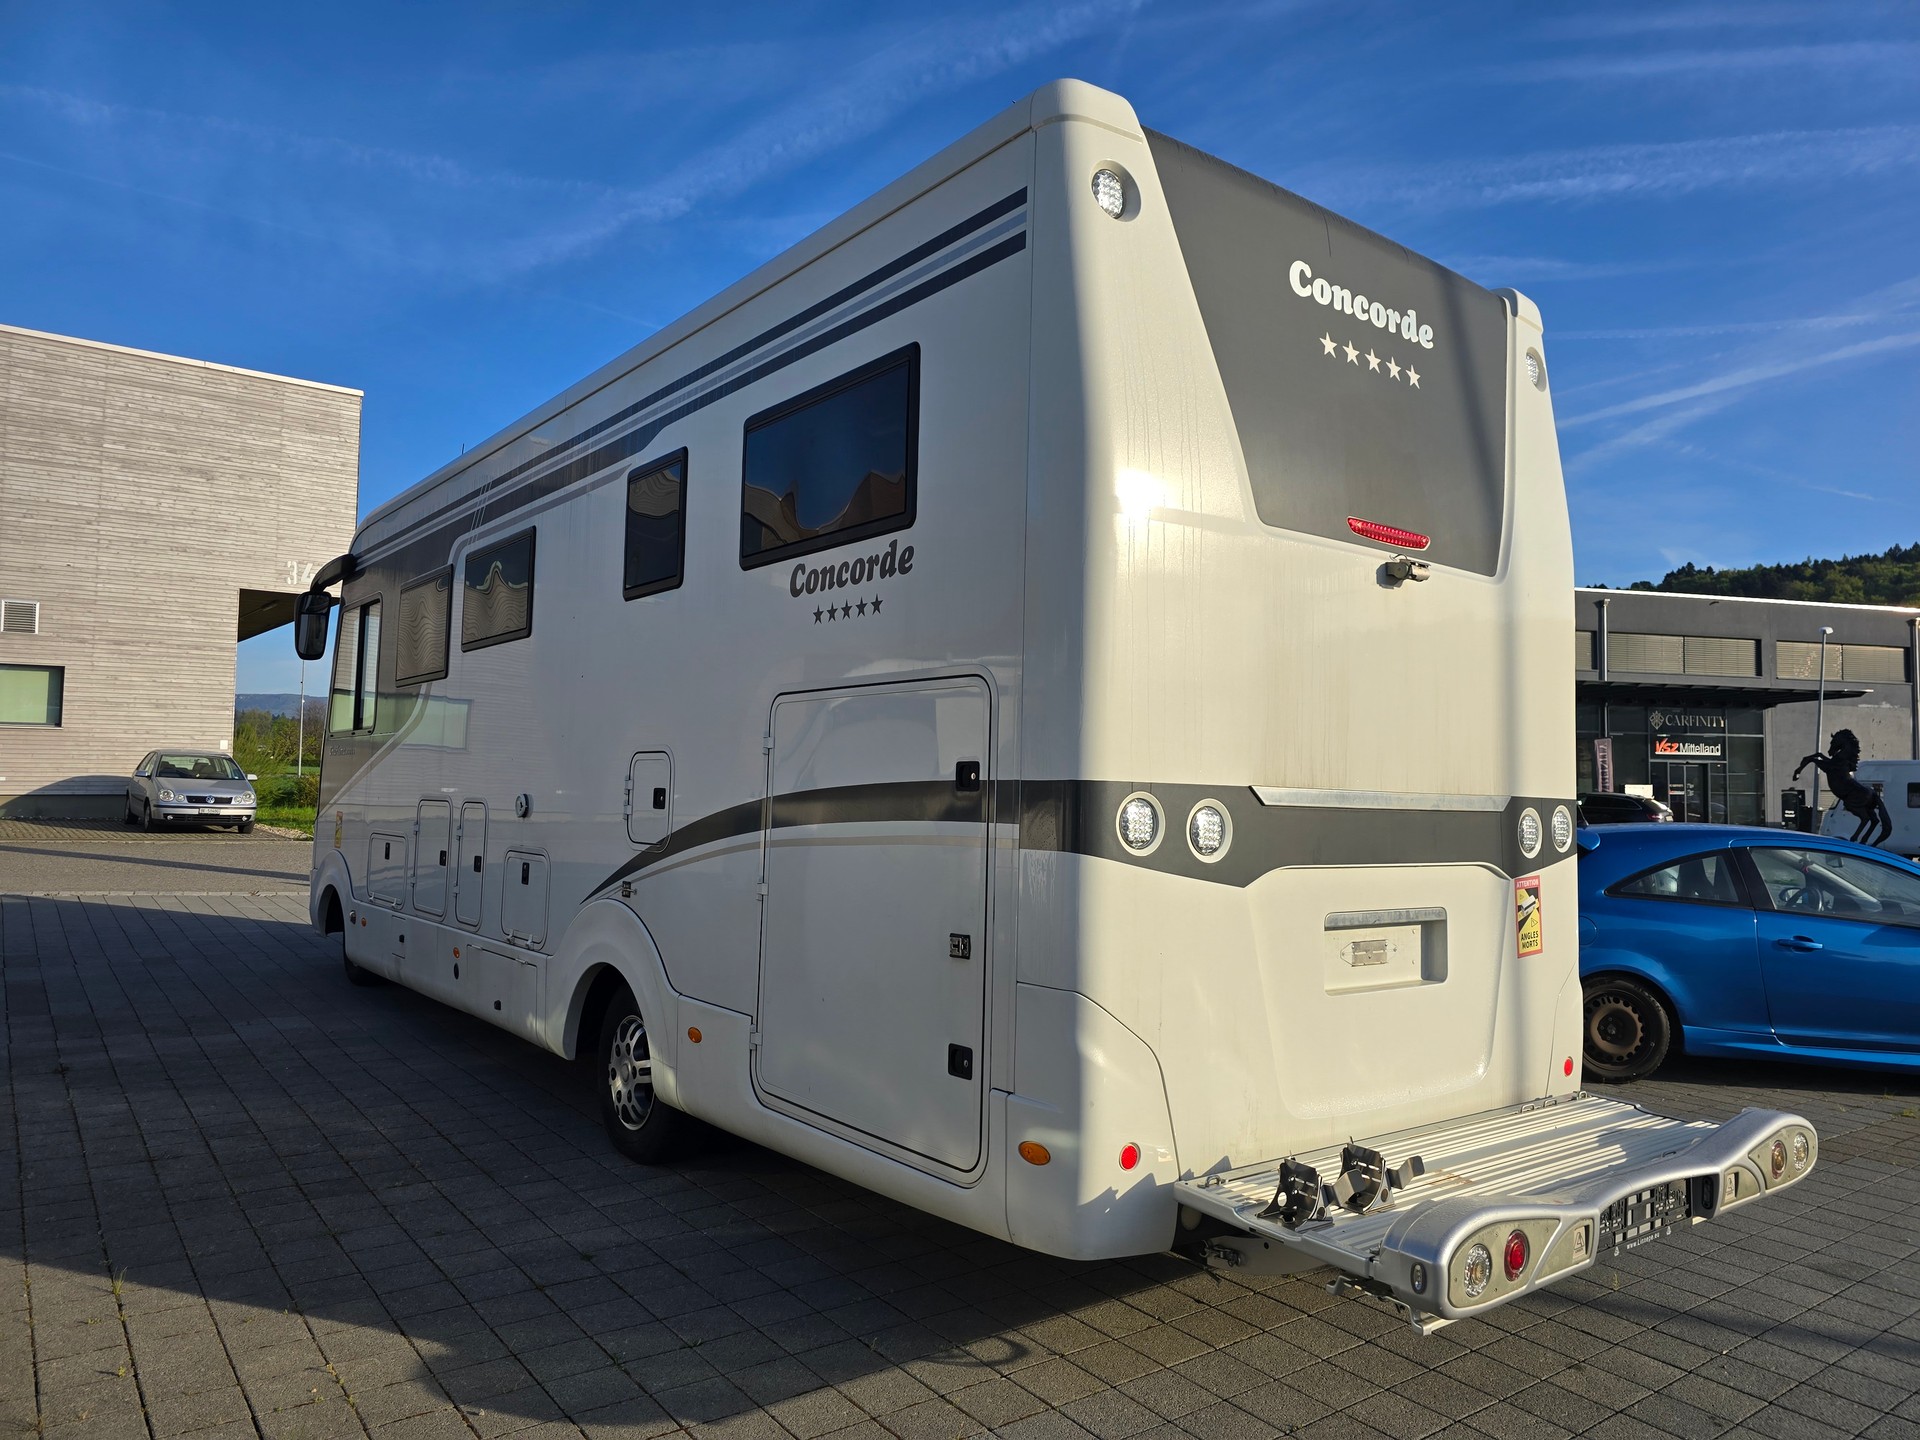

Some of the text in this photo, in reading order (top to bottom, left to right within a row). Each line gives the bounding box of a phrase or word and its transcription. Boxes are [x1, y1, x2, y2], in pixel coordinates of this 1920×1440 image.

[1289, 260, 1434, 349] Concorde
[790, 539, 915, 598] Concorde
[1665, 714, 1726, 728] CARFINITY
[1680, 743, 1721, 754] Mittelland
[1516, 879, 1539, 888] ATTENTION
[1521, 931, 1539, 941] ANGLES
[1521, 940, 1539, 949] MORTS
